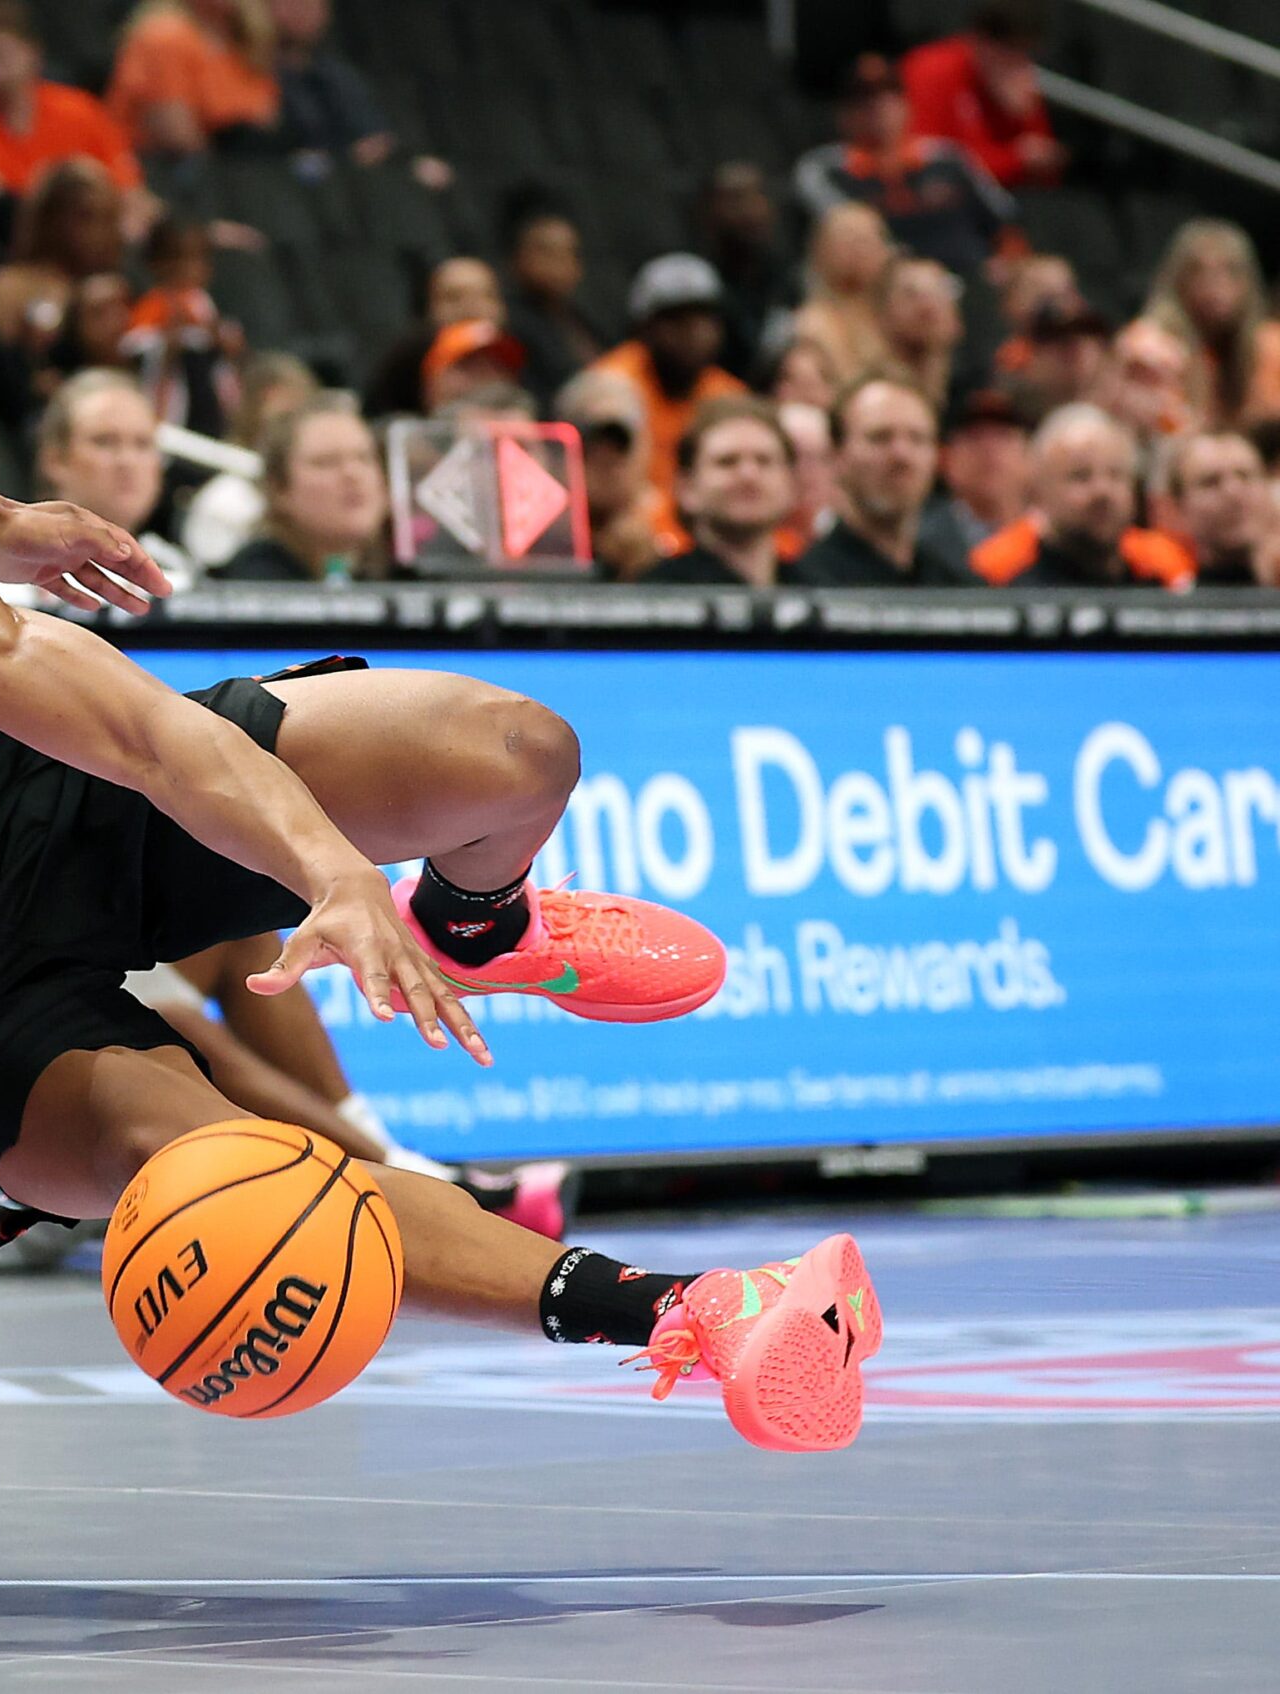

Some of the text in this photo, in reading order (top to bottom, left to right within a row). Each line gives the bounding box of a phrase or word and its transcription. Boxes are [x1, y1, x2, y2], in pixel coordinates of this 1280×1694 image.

[532, 720, 1280, 899] mo Debit Car
[695, 922, 794, 1019] sh
[795, 916, 1068, 1016] Rewards.
[134, 1239, 209, 1337] EVO
[180, 1273, 328, 1406] Wilson
